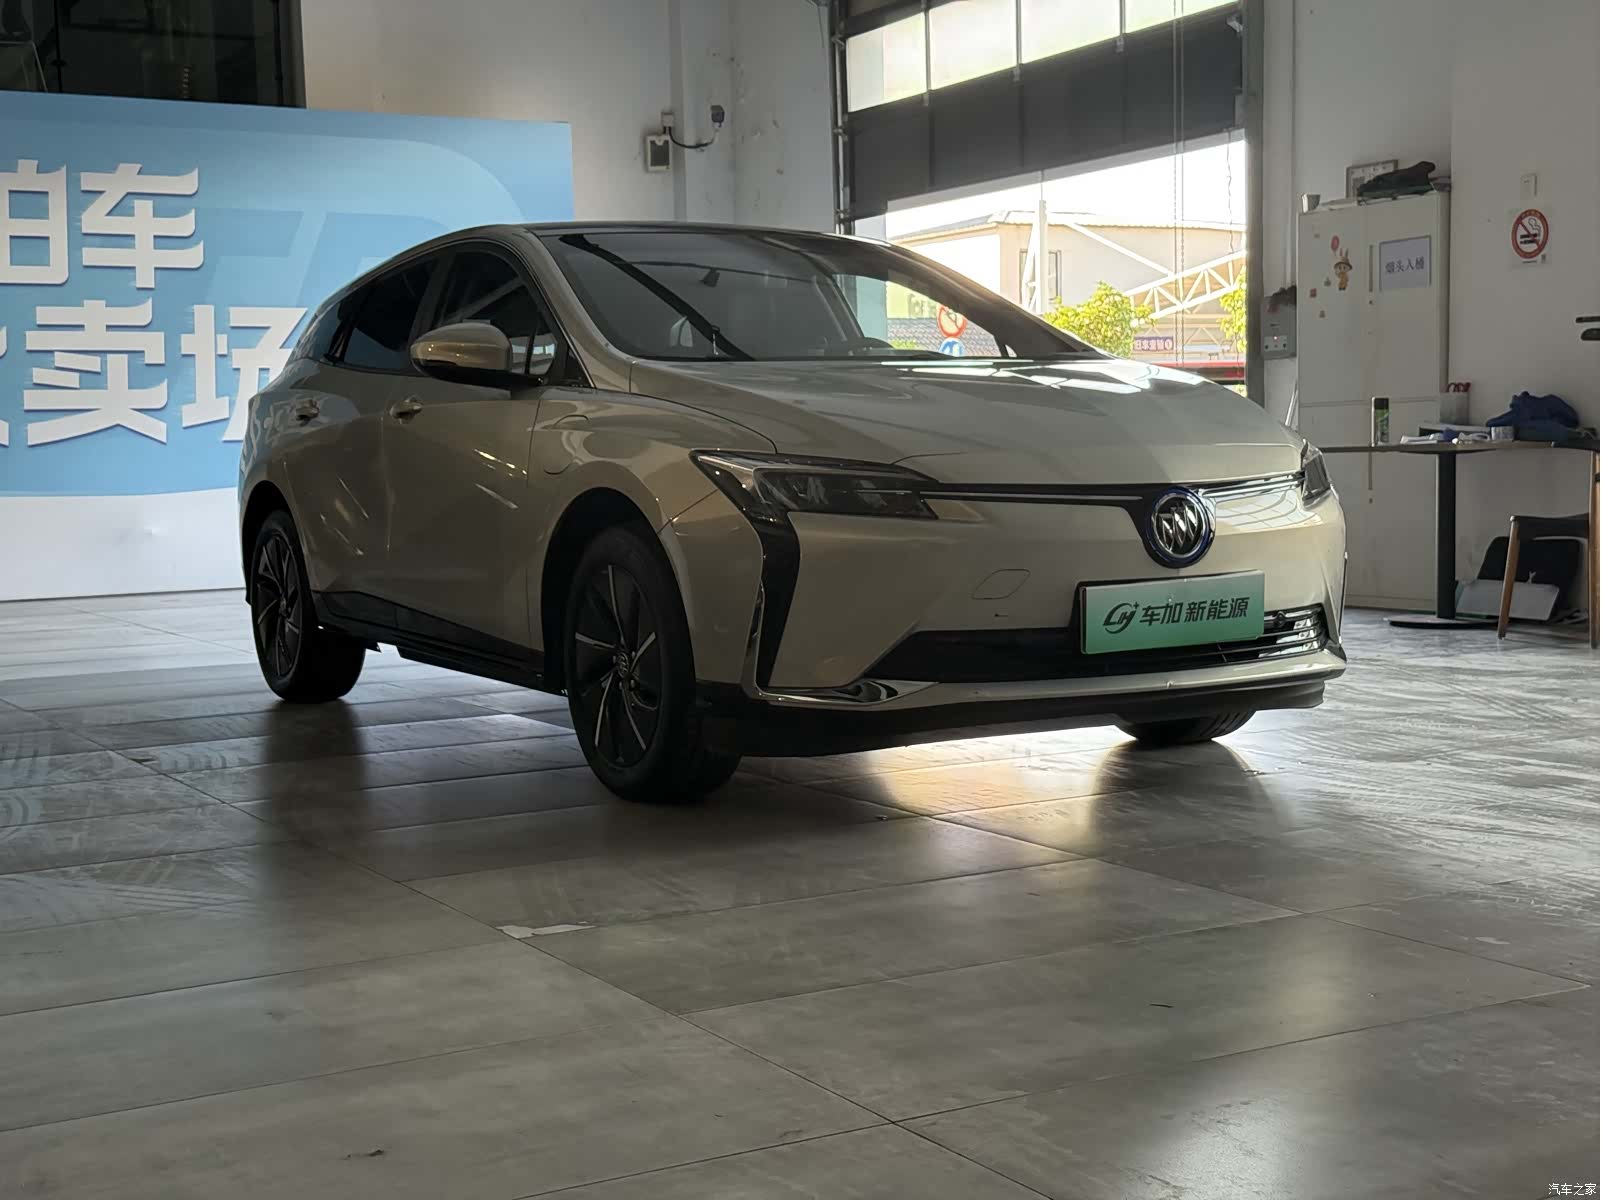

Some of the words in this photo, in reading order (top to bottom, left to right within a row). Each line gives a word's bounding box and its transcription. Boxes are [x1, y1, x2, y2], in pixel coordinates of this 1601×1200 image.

[0, 297, 307, 446] 卖场
[1139, 597, 1249, 626] 车加新能源
